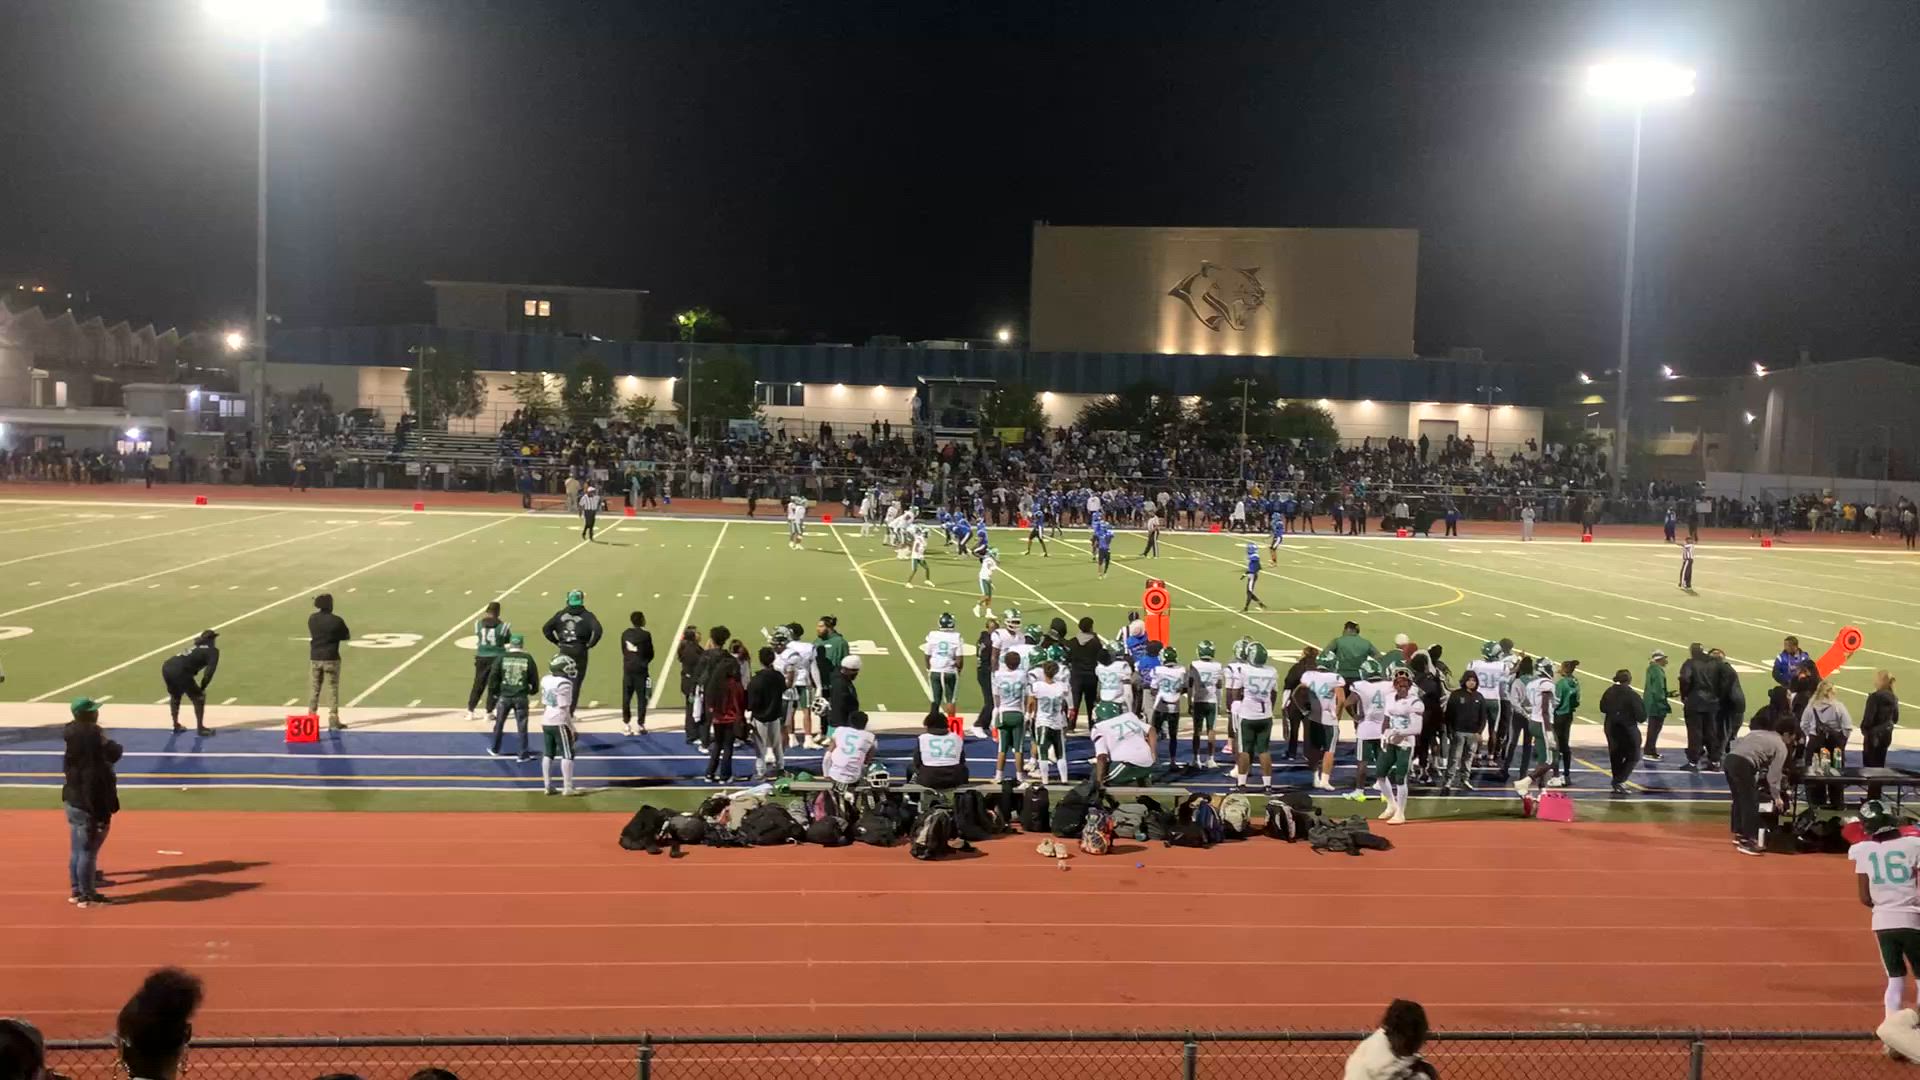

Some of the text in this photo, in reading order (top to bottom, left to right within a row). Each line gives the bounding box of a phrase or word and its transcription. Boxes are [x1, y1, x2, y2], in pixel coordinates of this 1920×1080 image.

[480, 628, 496, 646] 14
[1248, 676, 1274, 695] 57
[1371, 690, 1385, 709] 4
[290, 717, 314, 737] 30
[841, 734, 859, 755] 5
[929, 738, 956, 758] 52
[1868, 850, 1910, 885] 16
